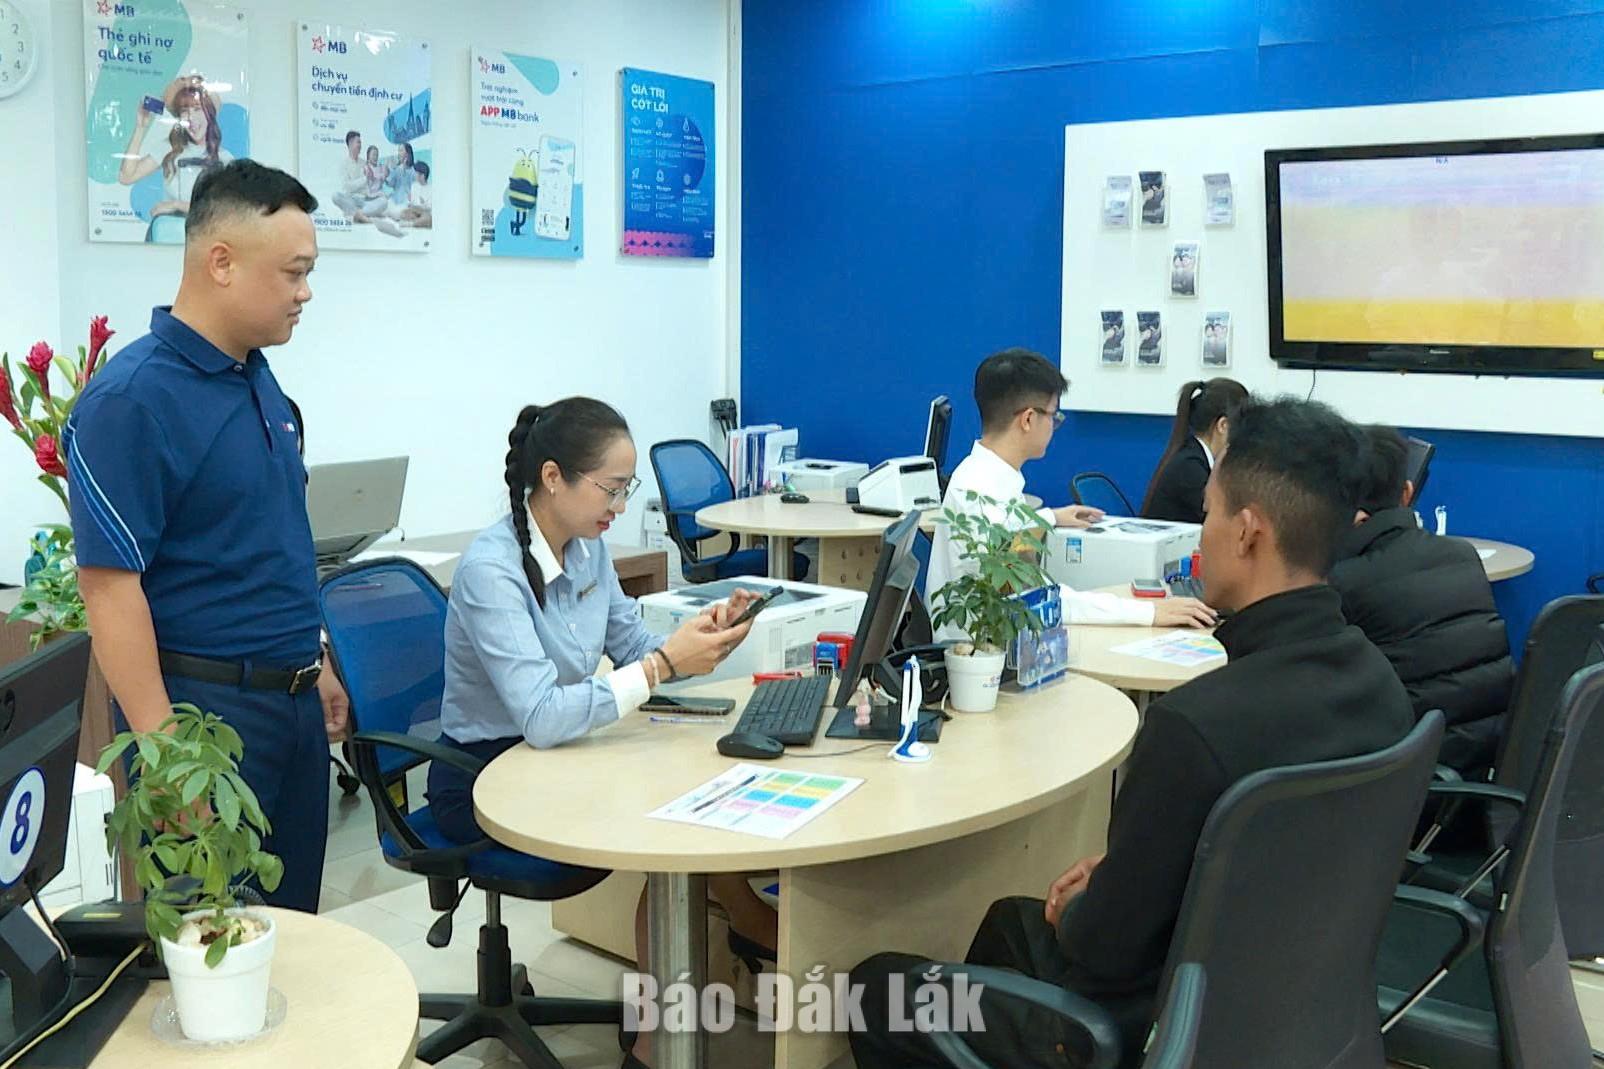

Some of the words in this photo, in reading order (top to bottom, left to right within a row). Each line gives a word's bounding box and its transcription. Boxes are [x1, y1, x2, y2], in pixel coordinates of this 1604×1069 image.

[114, 4, 135, 17] MB
[128, 32, 151, 47] ghi
[155, 37, 174, 52] nợ
[328, 40, 347, 54] MB
[312, 65, 334, 80] Dịch
[336, 72, 348, 82] vụ
[491, 63, 505, 74] MB
[368, 87, 389, 101] định
[391, 93, 403, 101] cư
[480, 105, 500, 117] APP
[10, 791, 33, 855] 8
